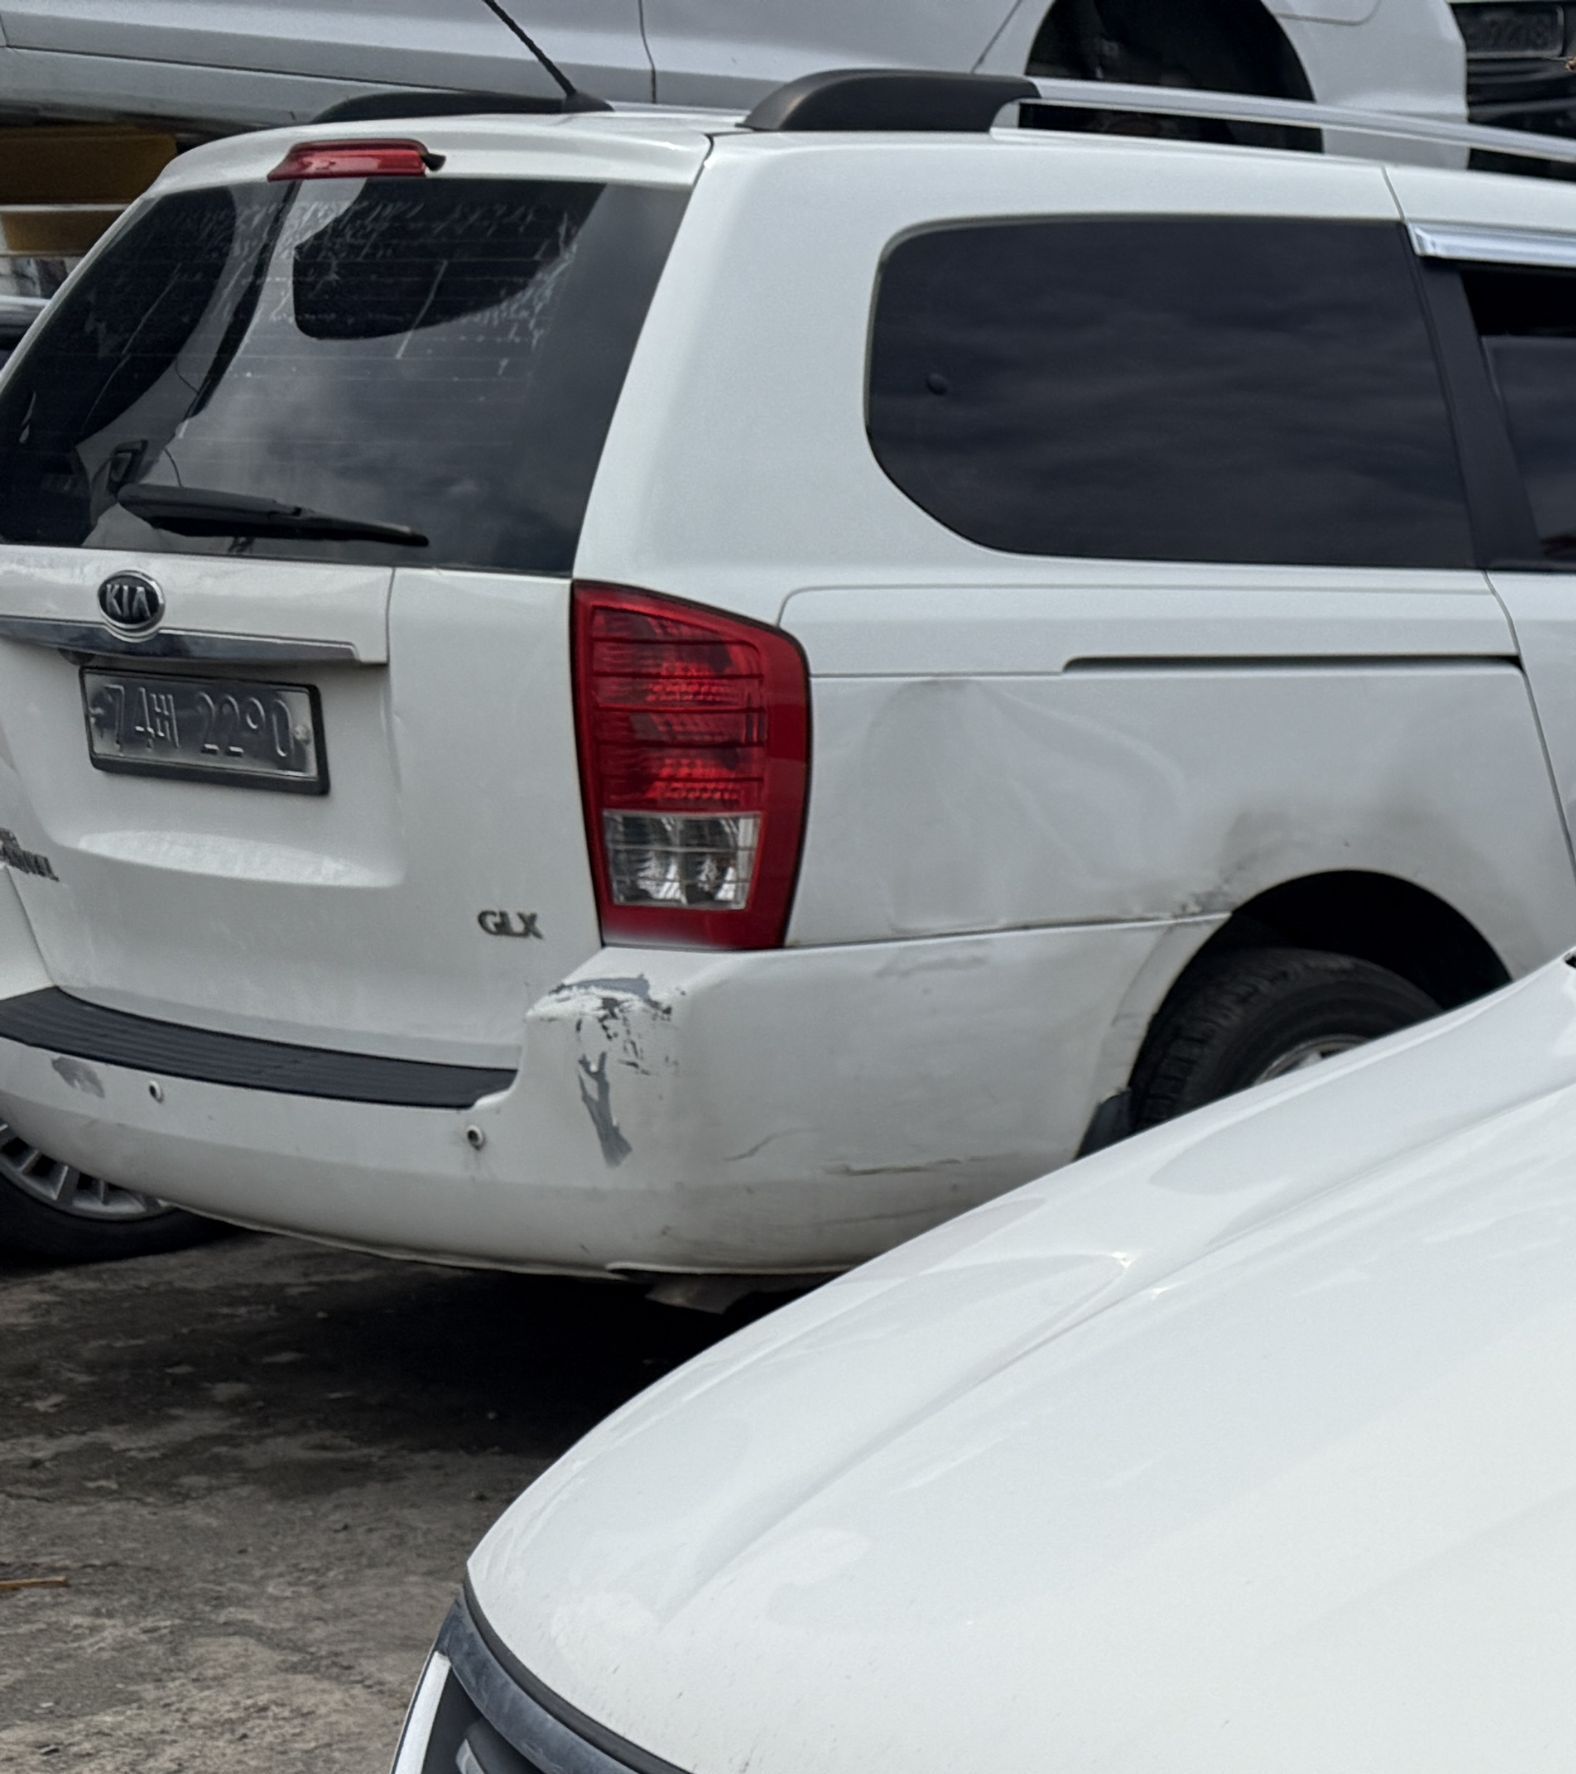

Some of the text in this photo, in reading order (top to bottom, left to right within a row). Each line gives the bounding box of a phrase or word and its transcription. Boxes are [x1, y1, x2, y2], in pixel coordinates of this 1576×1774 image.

[105, 583, 151, 619] KIA
[195, 691, 295, 762] 2290
[477, 909, 545, 940] GLX
